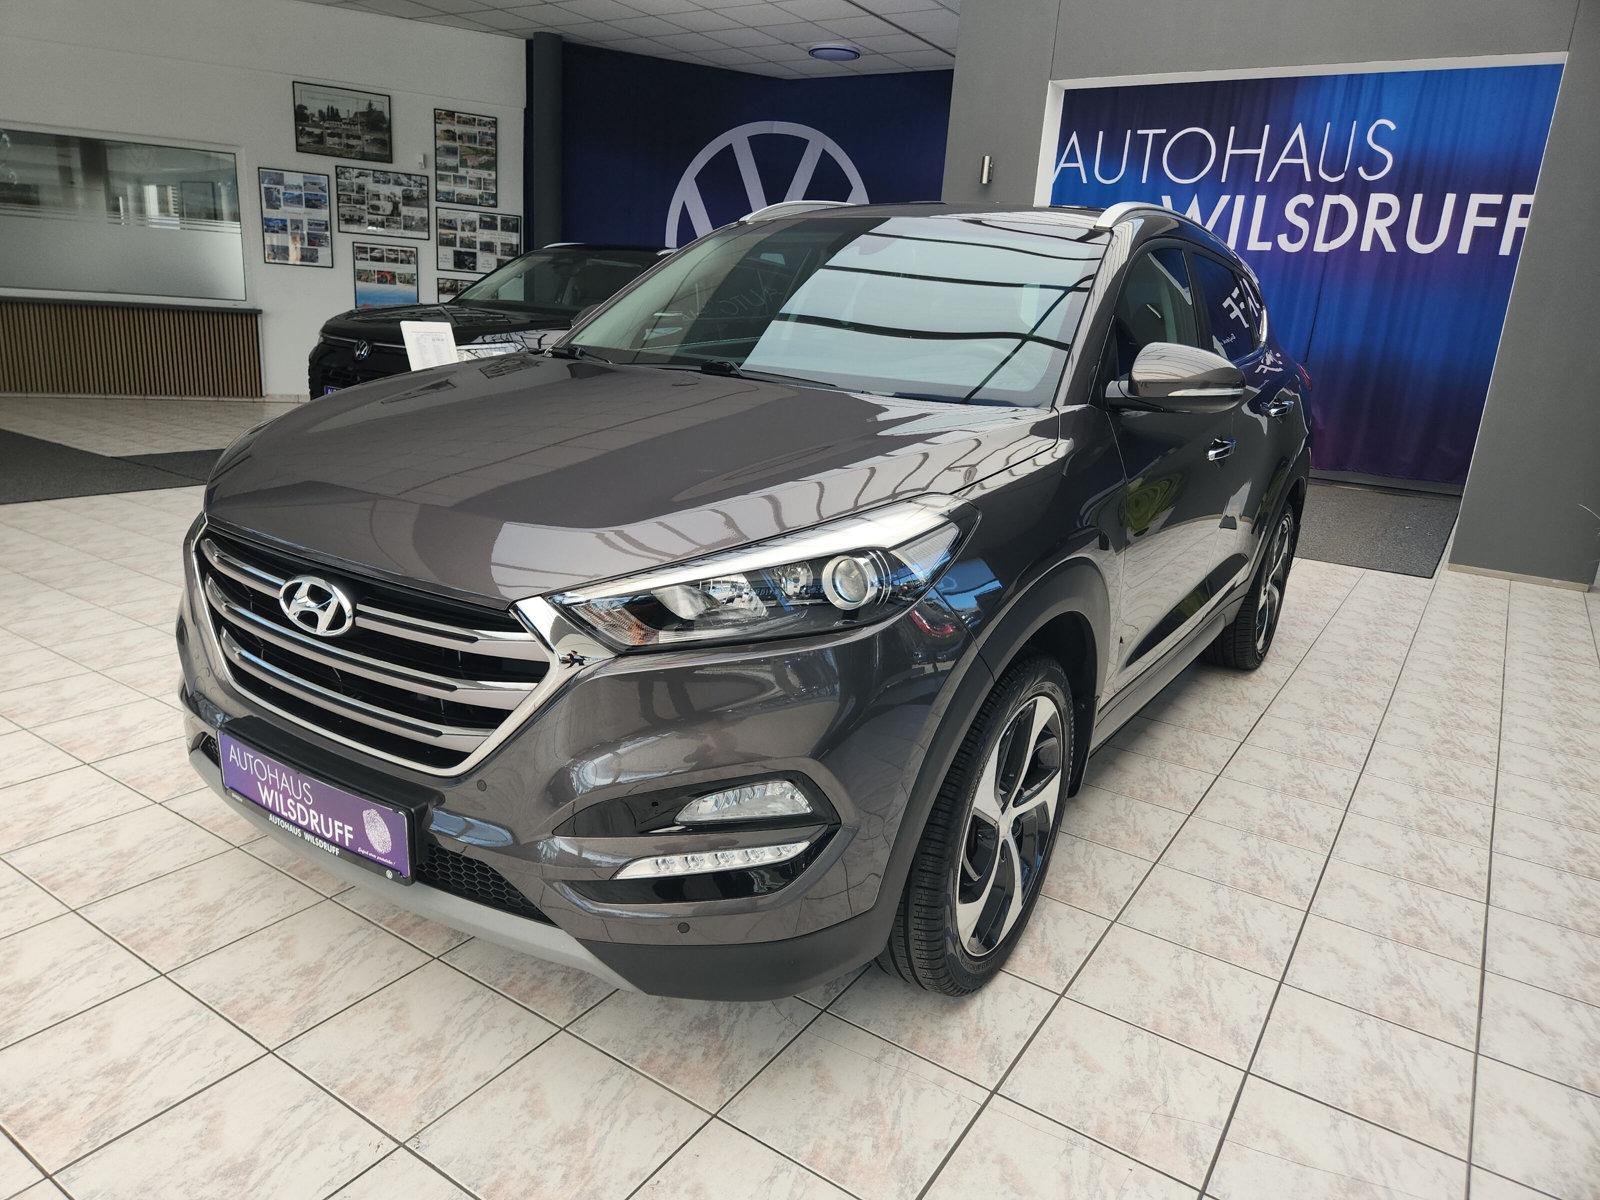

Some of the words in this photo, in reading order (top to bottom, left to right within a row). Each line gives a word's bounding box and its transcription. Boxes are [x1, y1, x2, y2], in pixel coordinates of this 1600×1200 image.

[1052, 118, 1397, 185] AUTOHAUS
[229, 745, 313, 806] AUTOHAUS
[257, 782, 354, 847] WILSDRUFF
[268, 815, 302, 838] AUTOHAUS
[303, 832, 340, 856] WILSDRUFF
